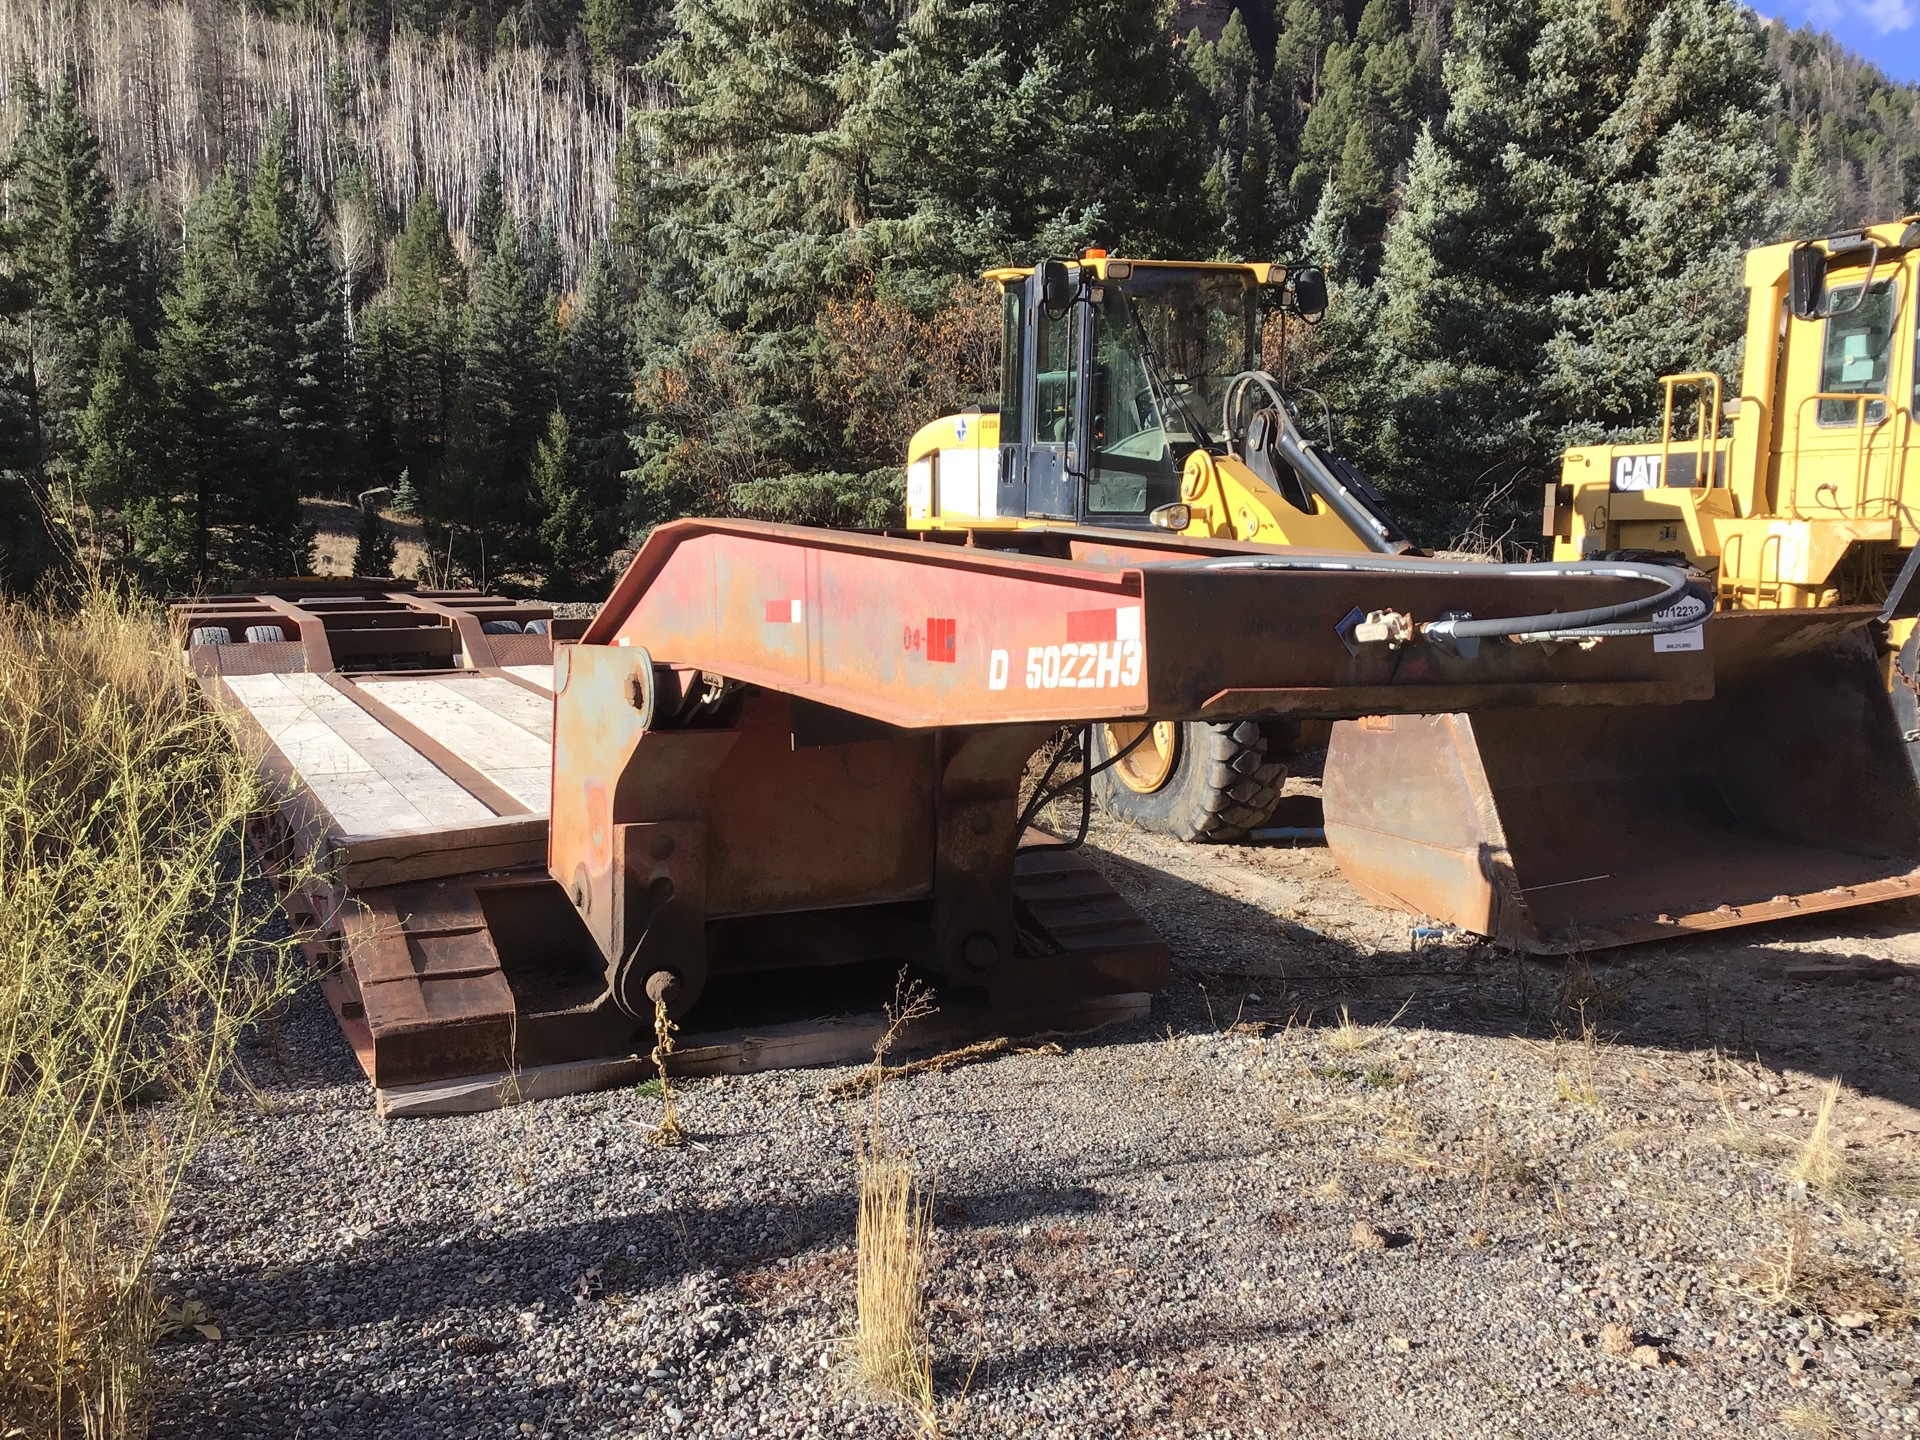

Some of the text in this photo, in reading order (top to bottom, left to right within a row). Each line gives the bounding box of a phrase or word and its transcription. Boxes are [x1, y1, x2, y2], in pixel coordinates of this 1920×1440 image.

[1616, 456, 1662, 491] CAT
[989, 639, 1142, 690] D 5022H3
